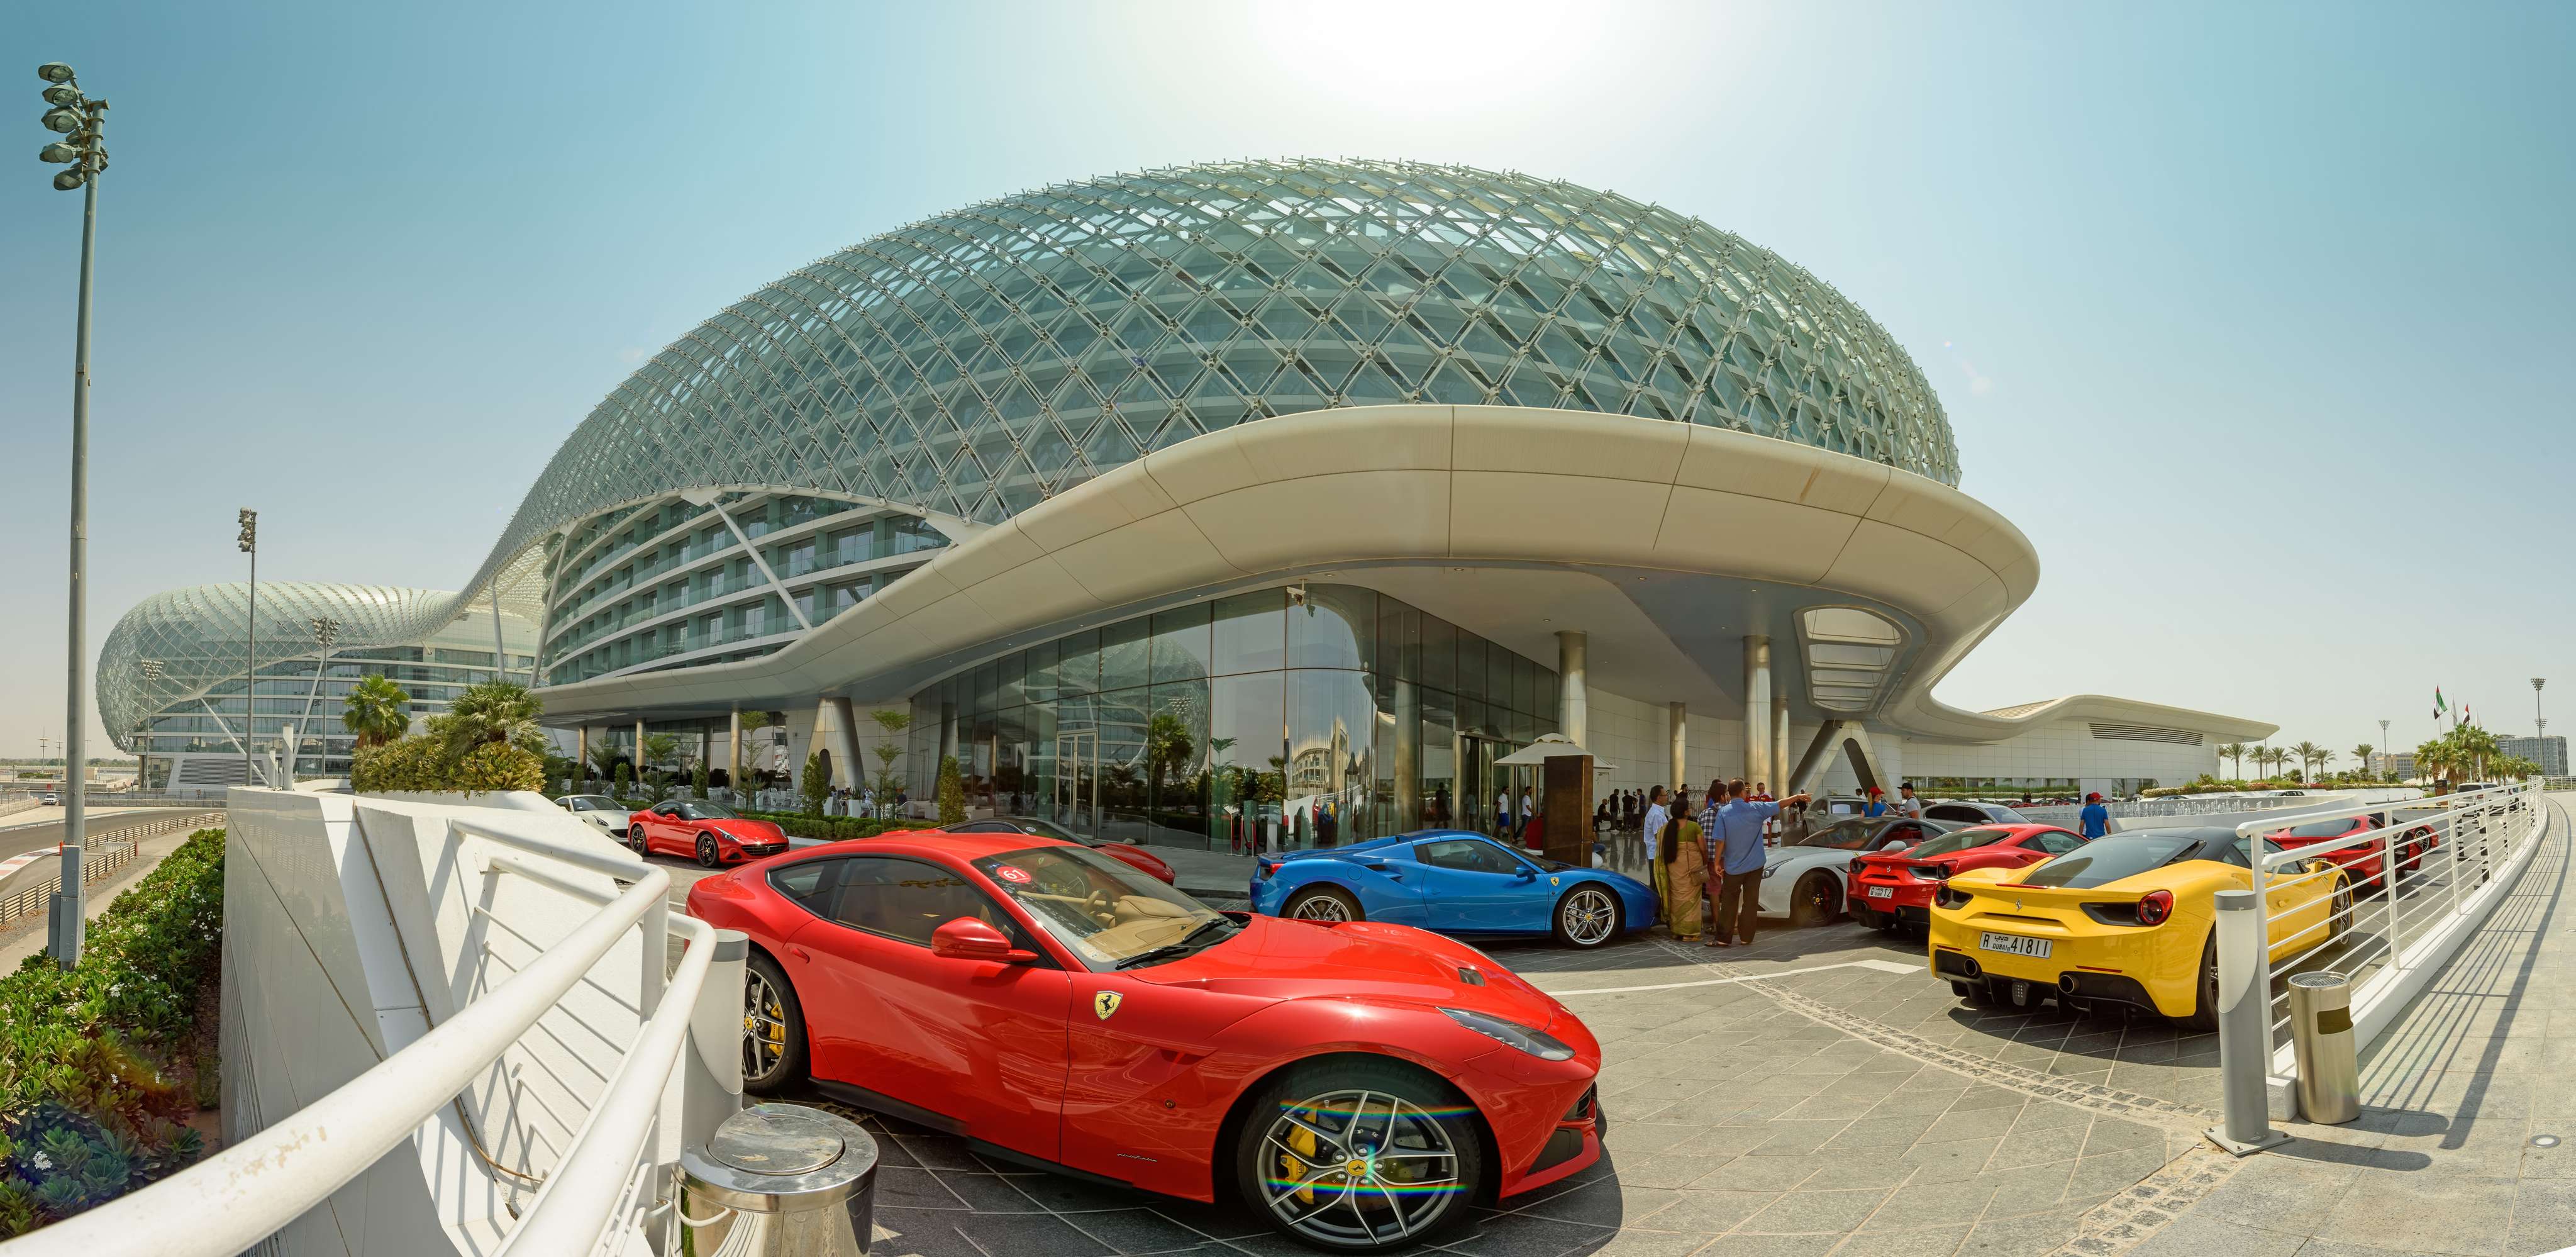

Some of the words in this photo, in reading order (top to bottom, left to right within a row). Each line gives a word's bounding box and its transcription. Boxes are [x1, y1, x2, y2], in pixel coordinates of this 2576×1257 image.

[1003, 869, 1026, 880] 61
[1983, 934, 1990, 948] R
[1992, 943, 2007, 951] DUBAI
[2011, 937, 2048, 956] 41811
